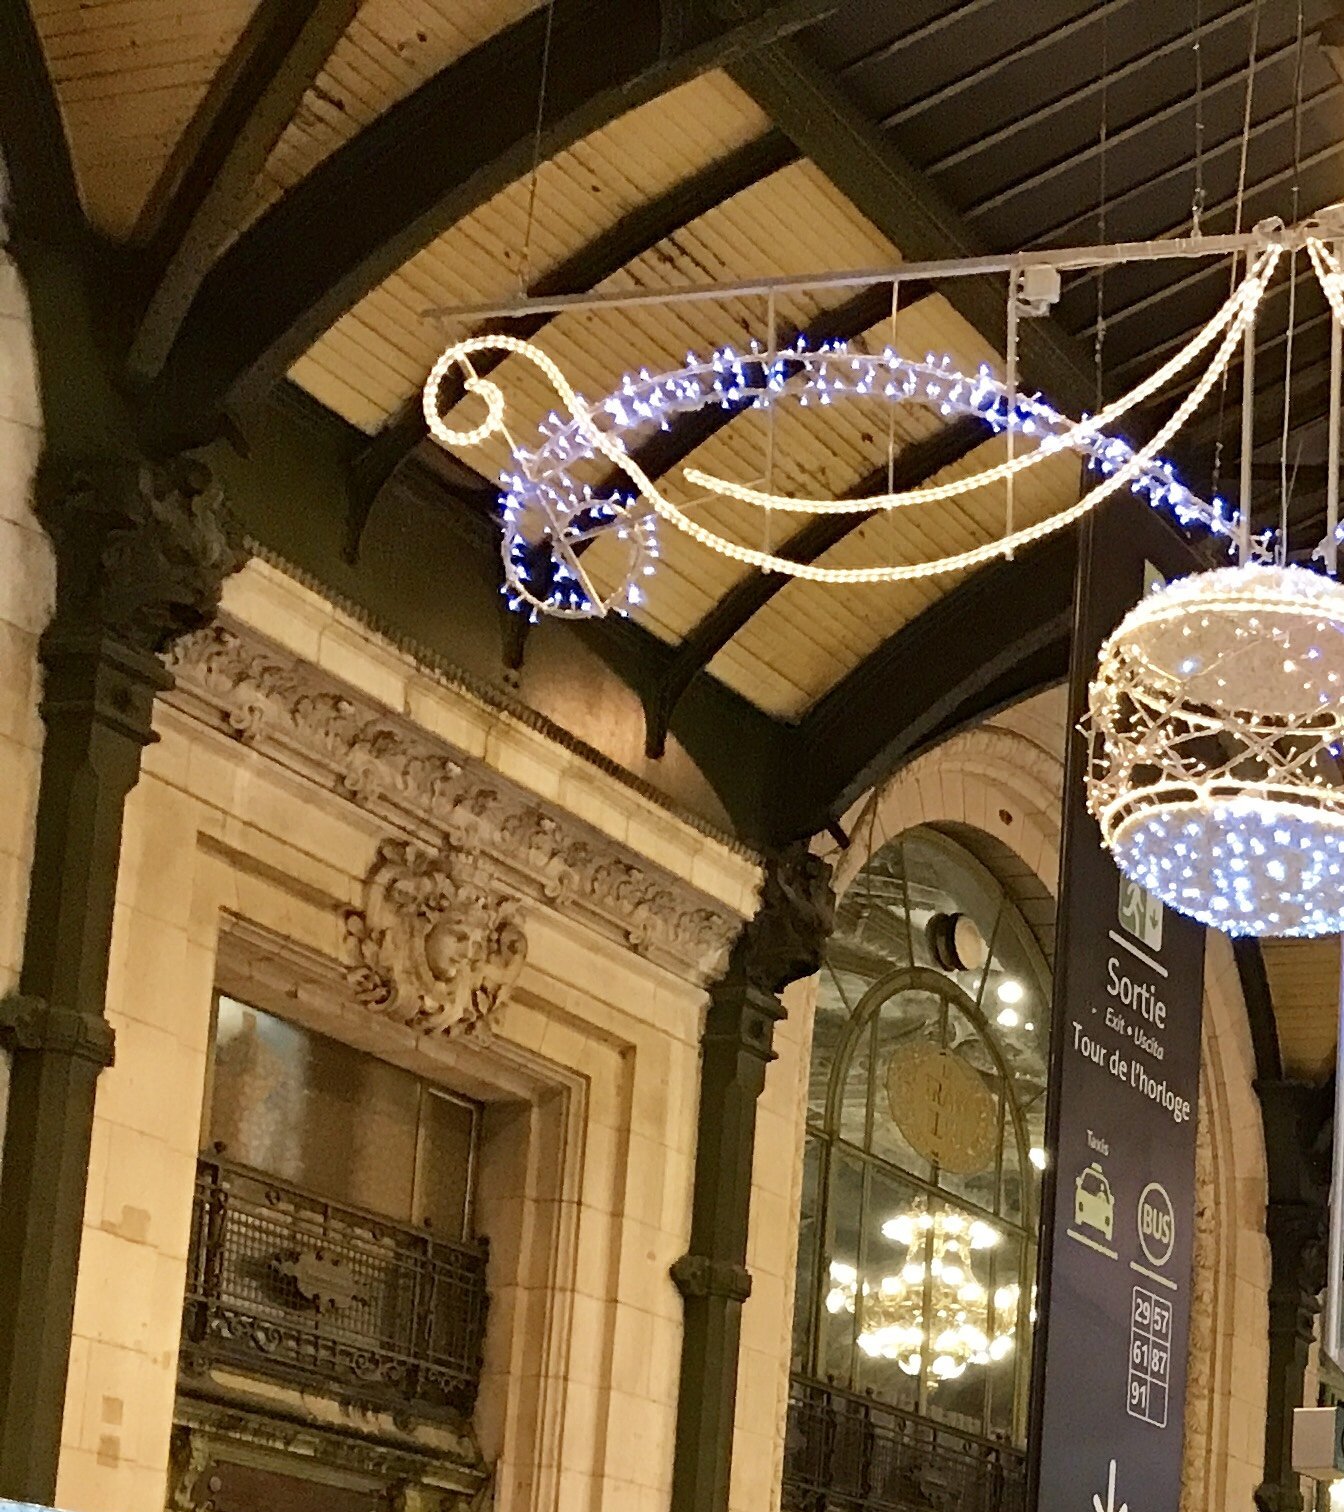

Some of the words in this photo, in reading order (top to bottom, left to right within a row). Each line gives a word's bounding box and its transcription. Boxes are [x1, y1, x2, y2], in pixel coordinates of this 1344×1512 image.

[1106, 956, 1167, 1029] Sortie
[1104, 1006, 1126, 1035] Exit
[1134, 1026, 1165, 1061] Uscita
[1072, 1020, 1108, 1067] Tour
[1109, 1049, 1128, 1082] de
[1130, 1060, 1191, 1123] l'horloge
[1086, 1128, 1110, 1157] Taxis
[1142, 1203, 1171, 1244] BUS
[1134, 1298, 1151, 1325] 29
[1152, 1306, 1170, 1334] 57
[1132, 1340, 1149, 1367] 61
[1150, 1348, 1168, 1375] 87
[1130, 1381, 1147, 1409] 91
